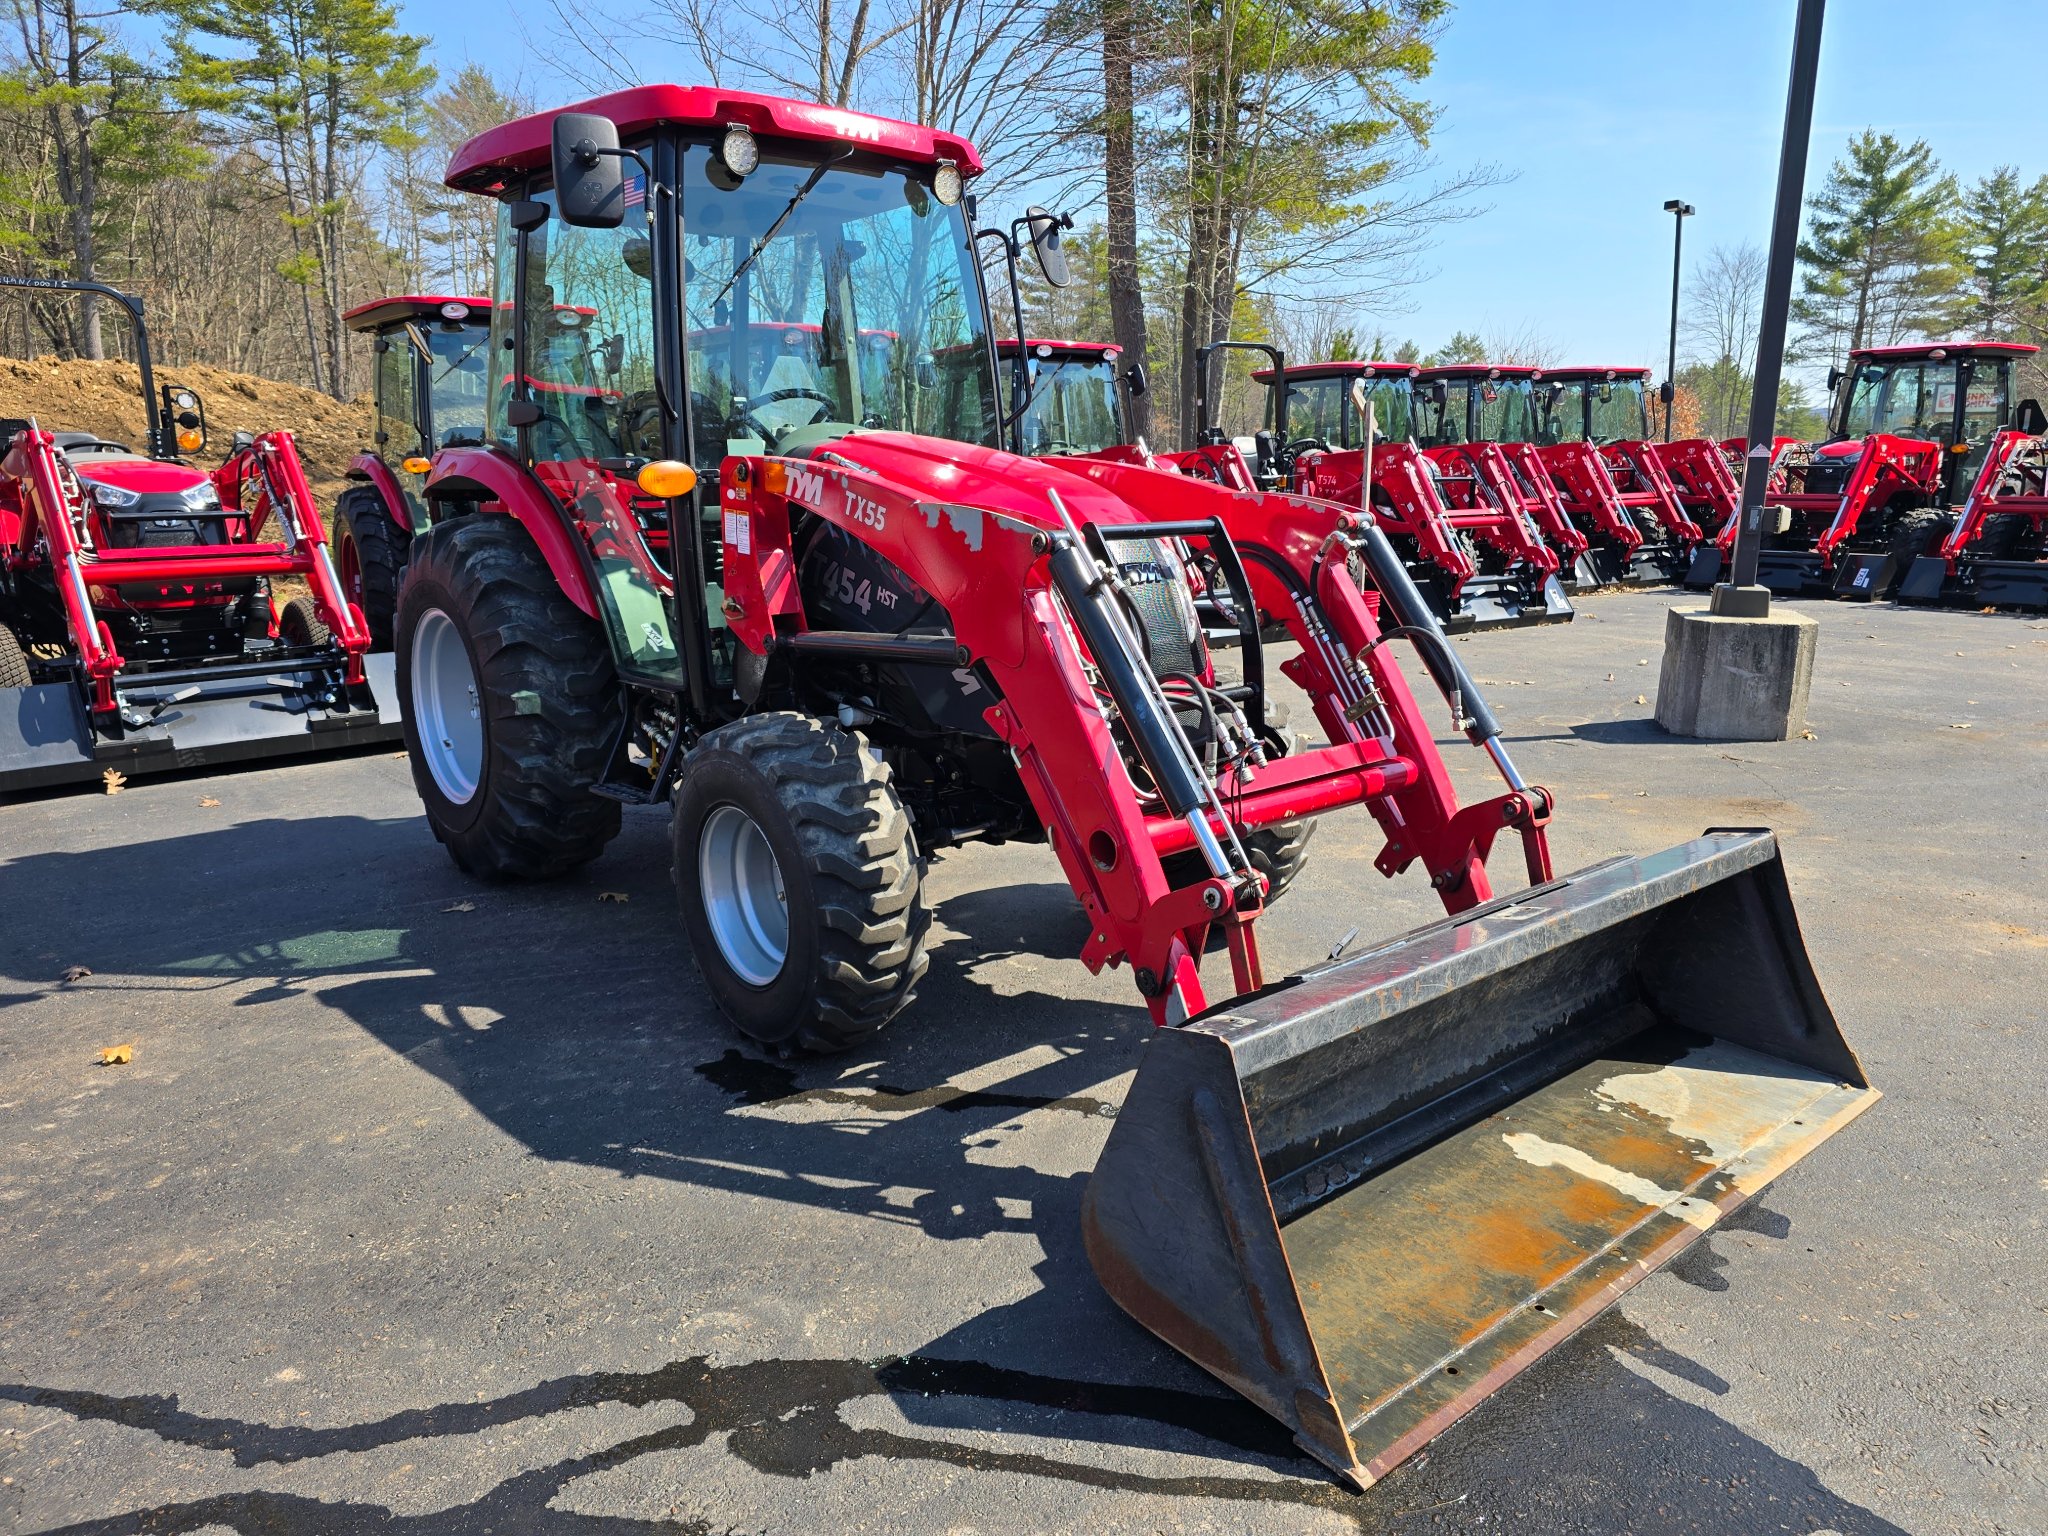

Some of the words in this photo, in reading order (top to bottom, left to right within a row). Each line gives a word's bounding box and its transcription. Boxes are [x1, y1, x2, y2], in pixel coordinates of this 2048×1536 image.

[784, 465, 824, 506] TYM
[1317, 474, 1337, 486] T574
[845, 490, 886, 531] TX55
[876, 585, 899, 610] HST
